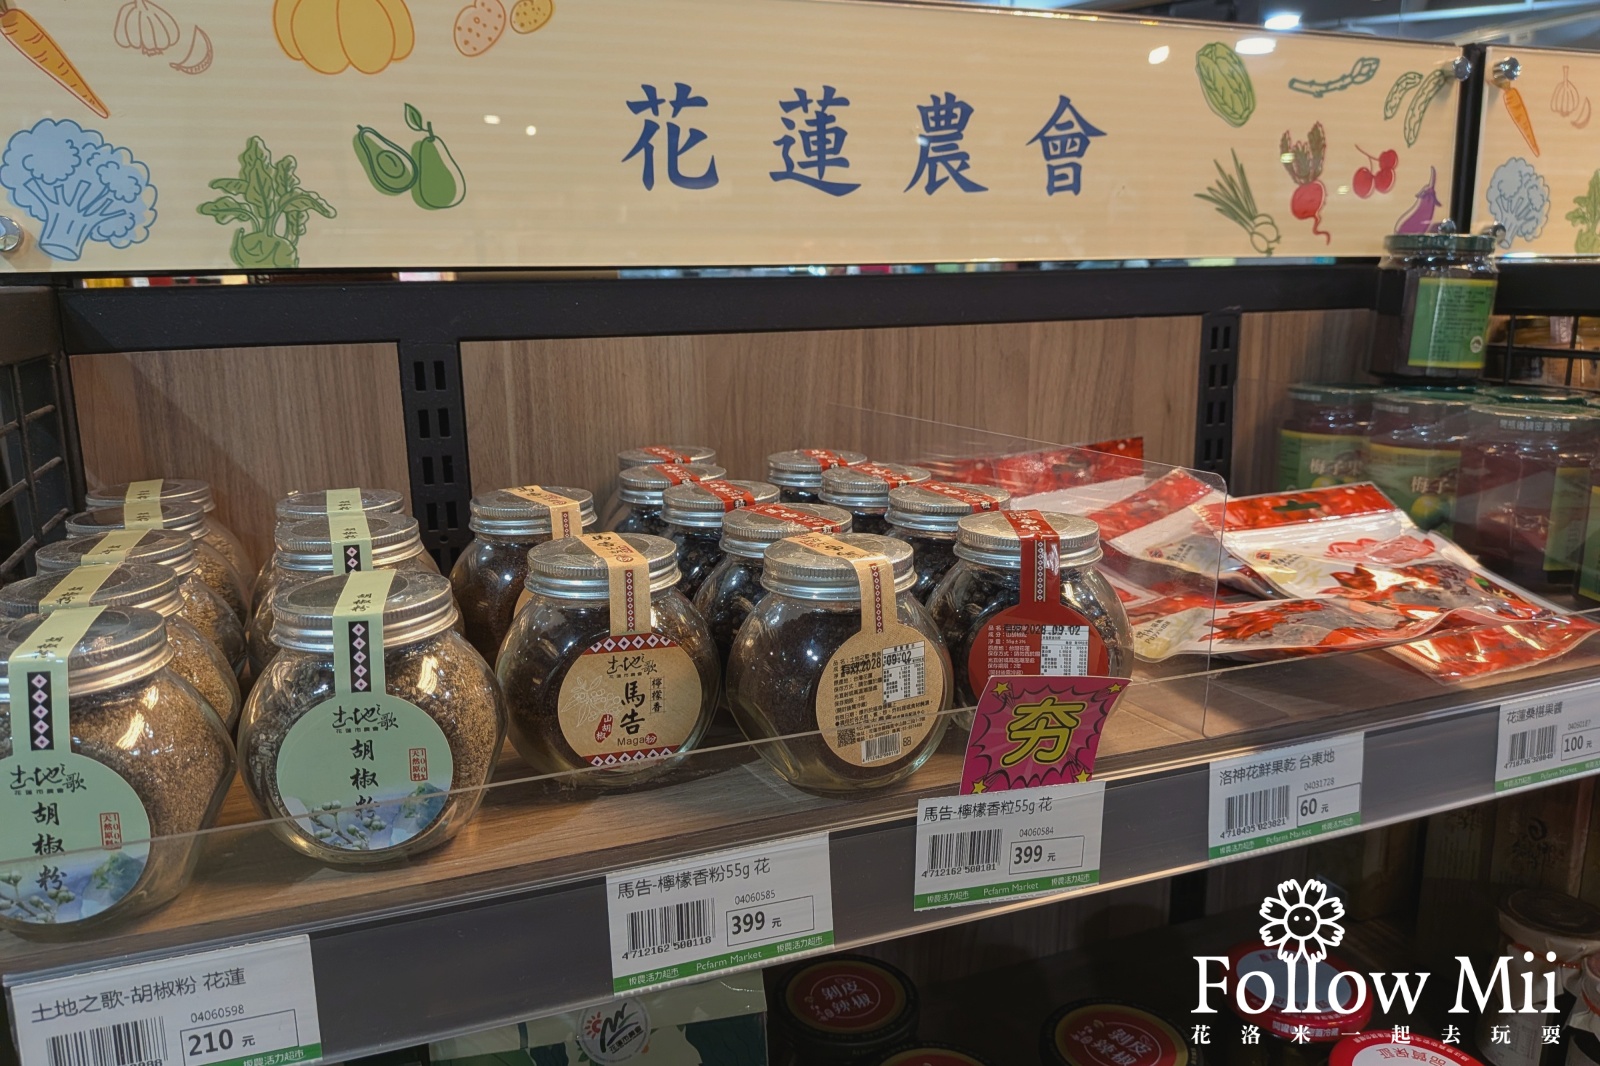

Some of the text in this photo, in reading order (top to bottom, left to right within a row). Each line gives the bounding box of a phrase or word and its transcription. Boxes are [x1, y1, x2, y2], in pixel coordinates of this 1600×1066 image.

[621, 82, 1107, 197] 花蓮農會
[620, 680, 646, 735] 馬告
[617, 737, 645, 746] Maga
[1000, 697, 1087, 766] 夯
[1563, 735, 1584, 752] 100
[1219, 749, 1335, 786] 洛神花鮮果乾 台東地
[923, 796, 1053, 822] 馬告-檸檬香粒55g 花
[1300, 797, 1329, 817] 60 元
[31, 801, 68, 891] 胡椒粉
[1013, 844, 1056, 865] 399 元
[617, 857, 771, 900] 馬告-檸檬香粉55g 花
[983, 882, 1039, 898] Pcfarm Market
[734, 889, 776, 906] 04060585
[731, 911, 782, 936] 399 元
[696, 950, 763, 972] Pcfarm Market
[31, 966, 247, 1023] 土地之歌-胡椒粉 花蓮
[190, 1004, 245, 1023] 04060598
[188, 1029, 256, 1057] 210 元
